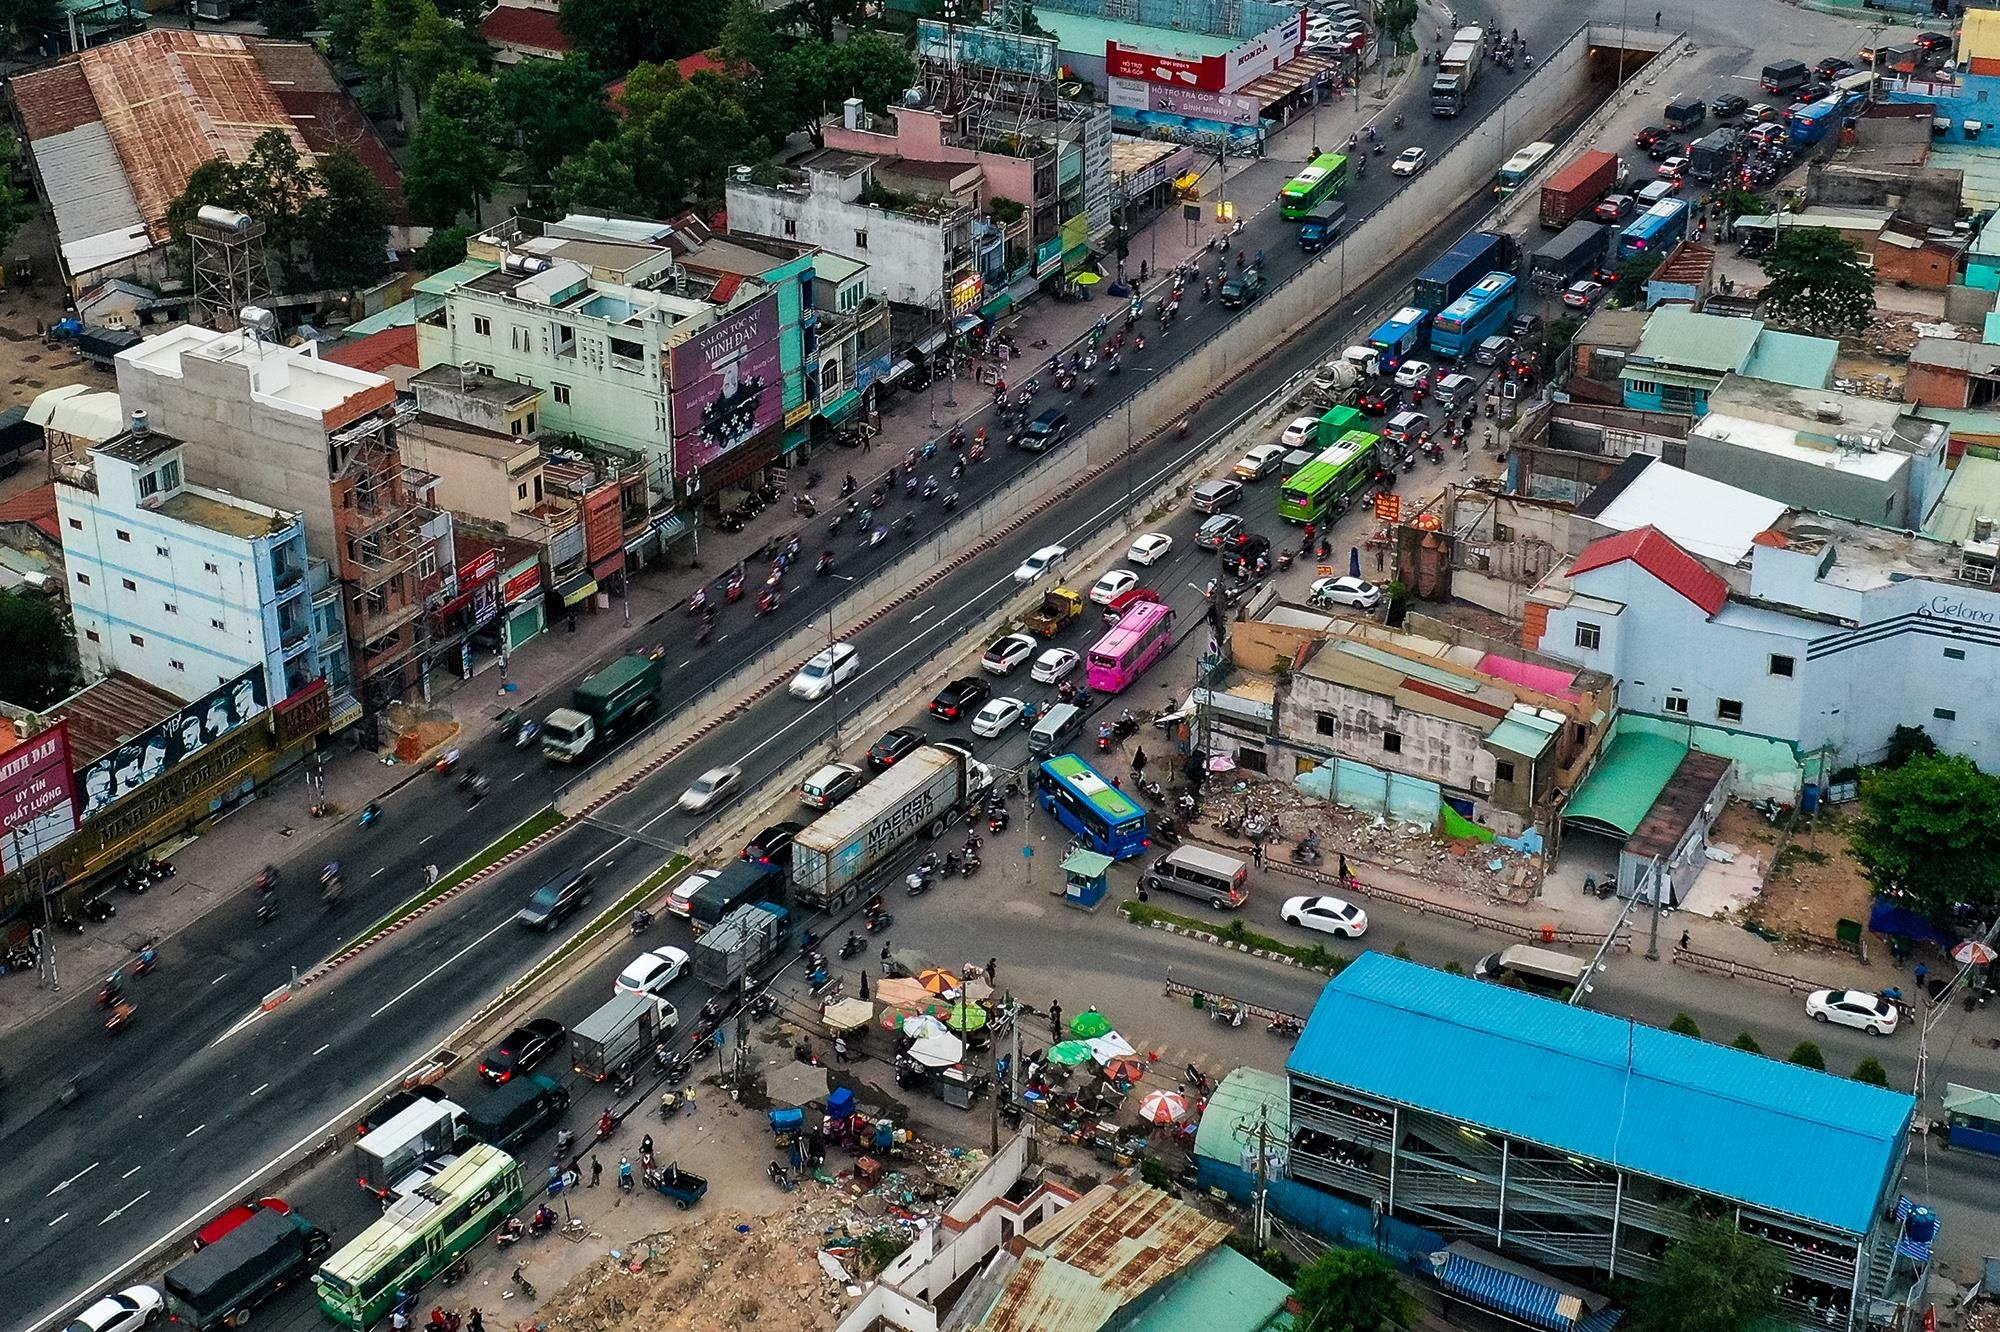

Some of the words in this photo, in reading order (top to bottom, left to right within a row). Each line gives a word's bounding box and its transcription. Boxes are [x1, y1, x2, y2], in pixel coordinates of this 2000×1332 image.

[1238, 44, 1268, 66] HONDA
[700, 327, 729, 350] SALON
[705, 336, 734, 363] MINH
[15, 788, 28, 803] UY
[30, 778, 46, 795] TÍN
[3, 804, 29, 827] CHẤT
[30, 786, 62, 811] LƯỢNG
[868, 789, 933, 844] MAERSK
